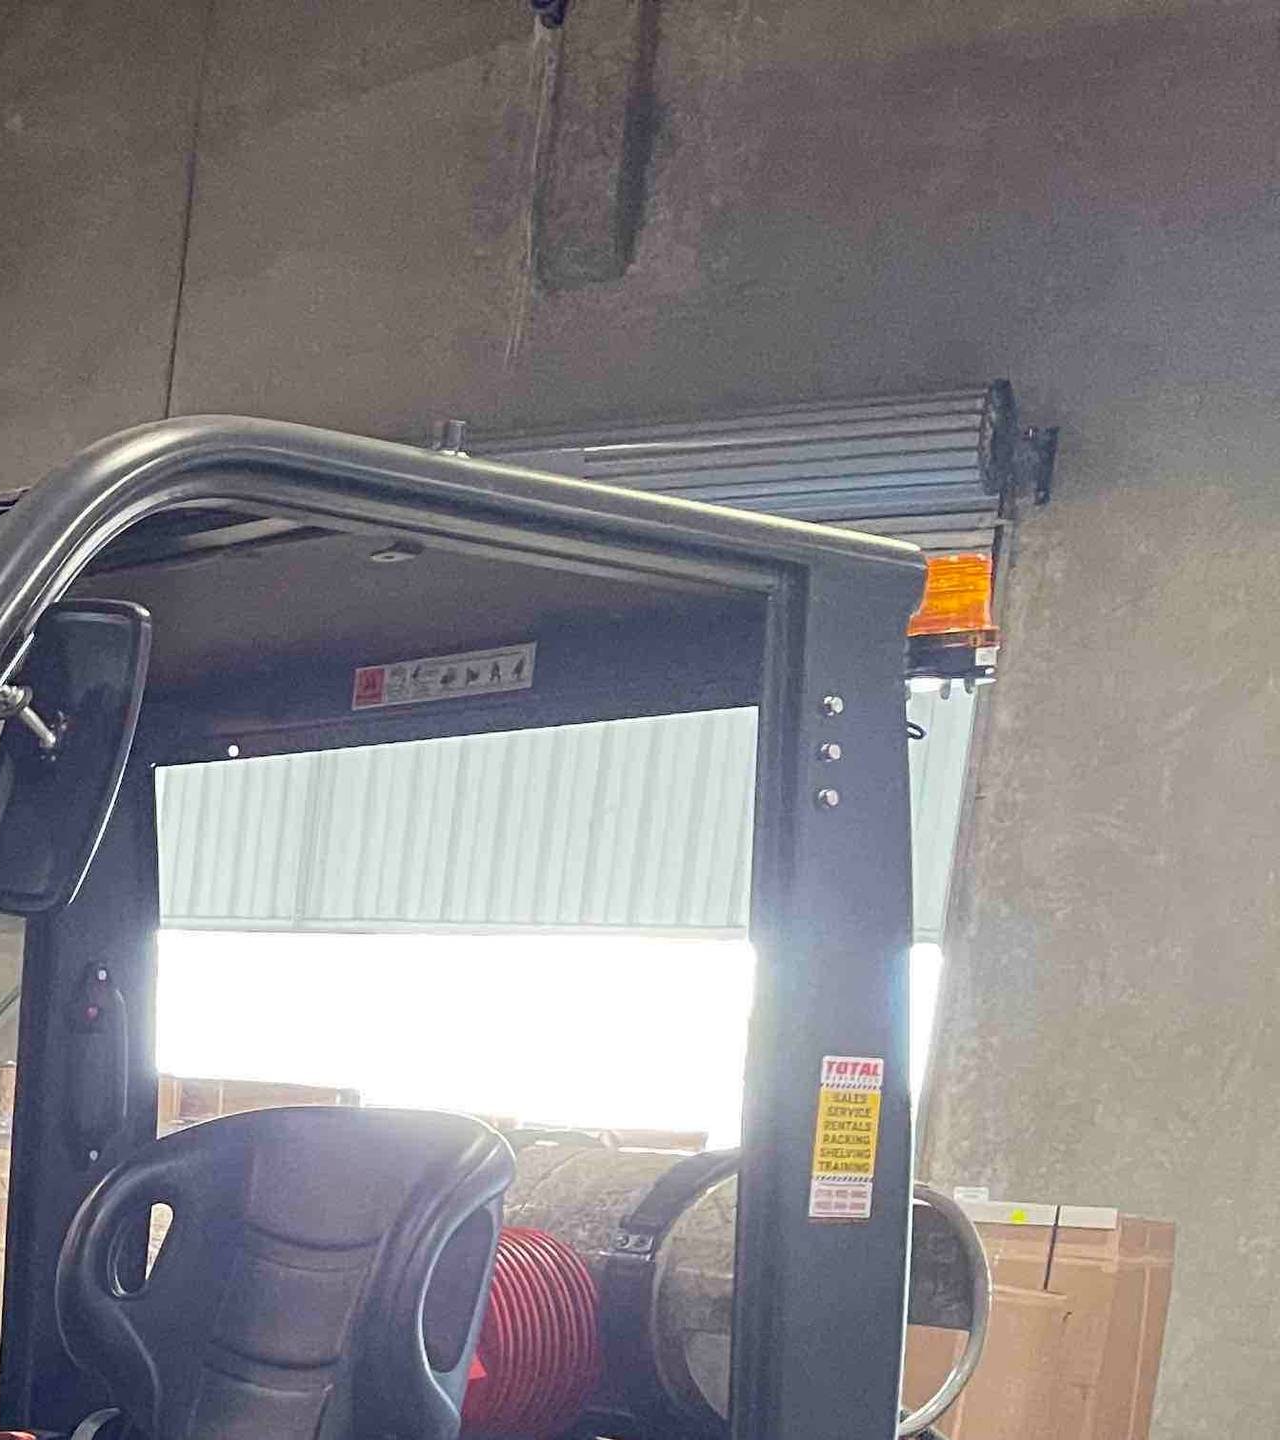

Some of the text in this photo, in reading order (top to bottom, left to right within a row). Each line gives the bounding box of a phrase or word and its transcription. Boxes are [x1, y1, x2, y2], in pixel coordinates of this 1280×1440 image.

[824, 1060, 881, 1076] TOTAL
[823, 1120, 872, 1132] RENTALS
[822, 1134, 871, 1146] RACKING
[819, 1148, 871, 1160] SHELVING
[817, 1161, 870, 1173] TRAINING
